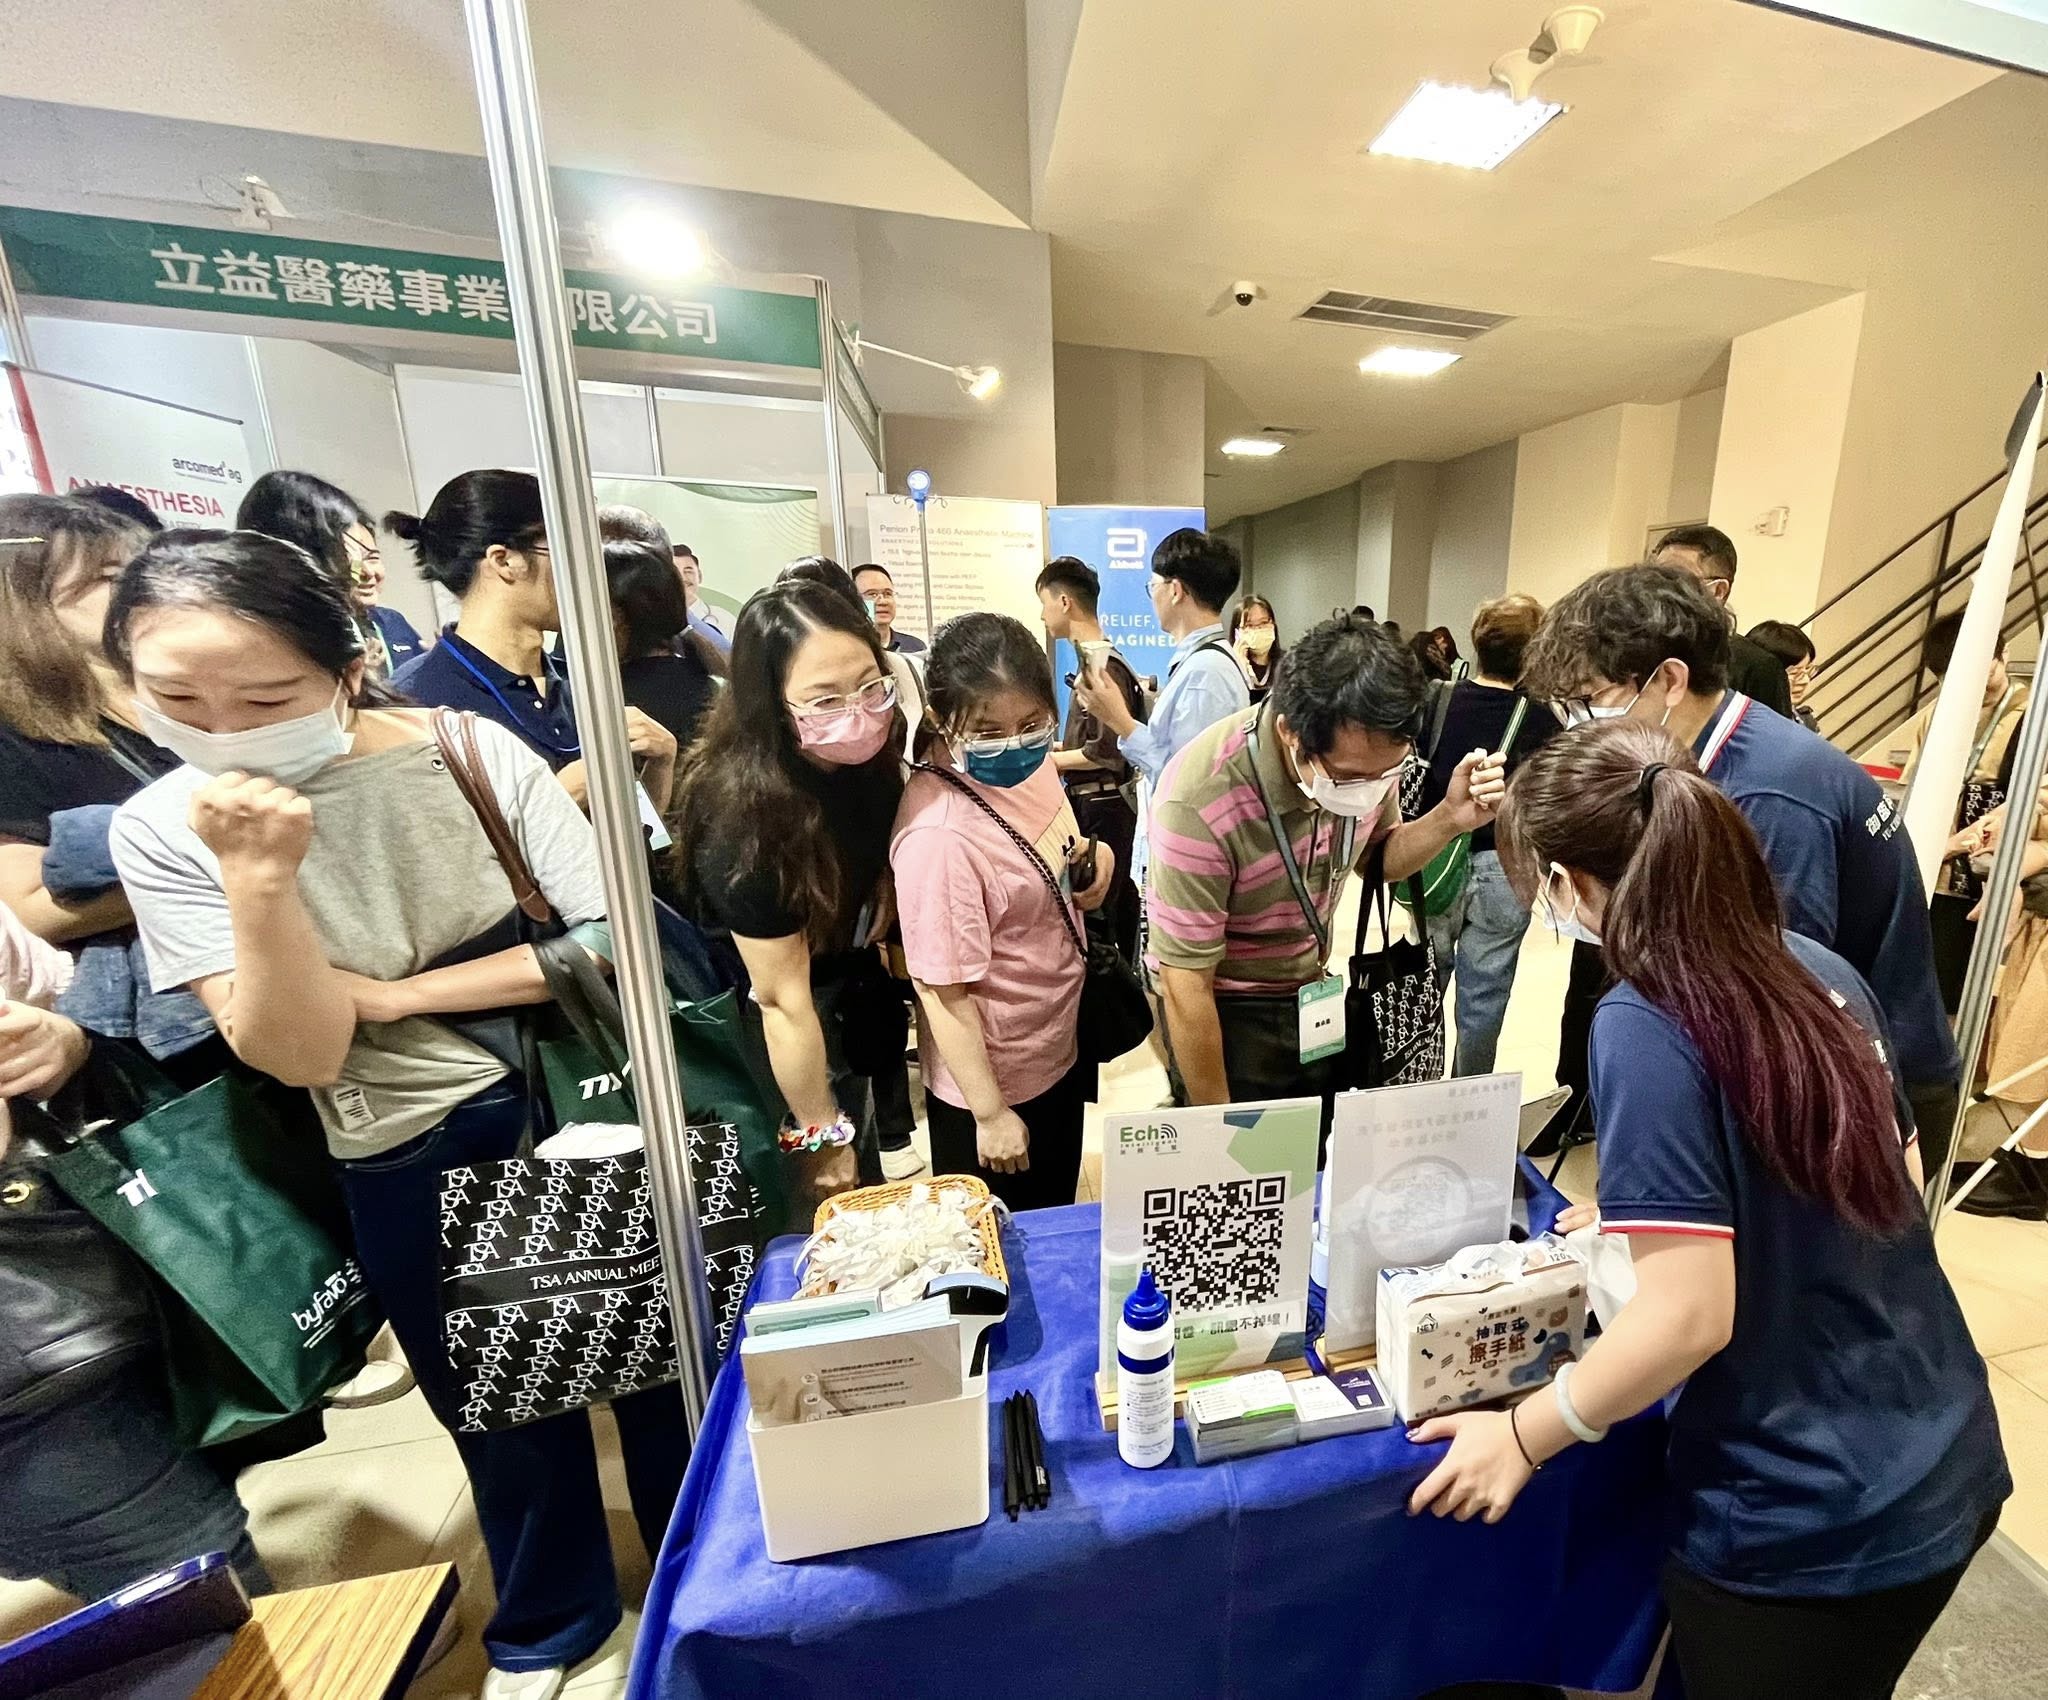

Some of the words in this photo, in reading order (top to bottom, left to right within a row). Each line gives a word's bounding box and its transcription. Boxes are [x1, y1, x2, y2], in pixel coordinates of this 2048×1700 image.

[151, 242, 717, 344] 立益醫藥事業限公司
[529, 1274, 562, 1290] TSA
[564, 1267, 628, 1285] ANNUAL
[1469, 1332, 1526, 1365] 擦手紙
